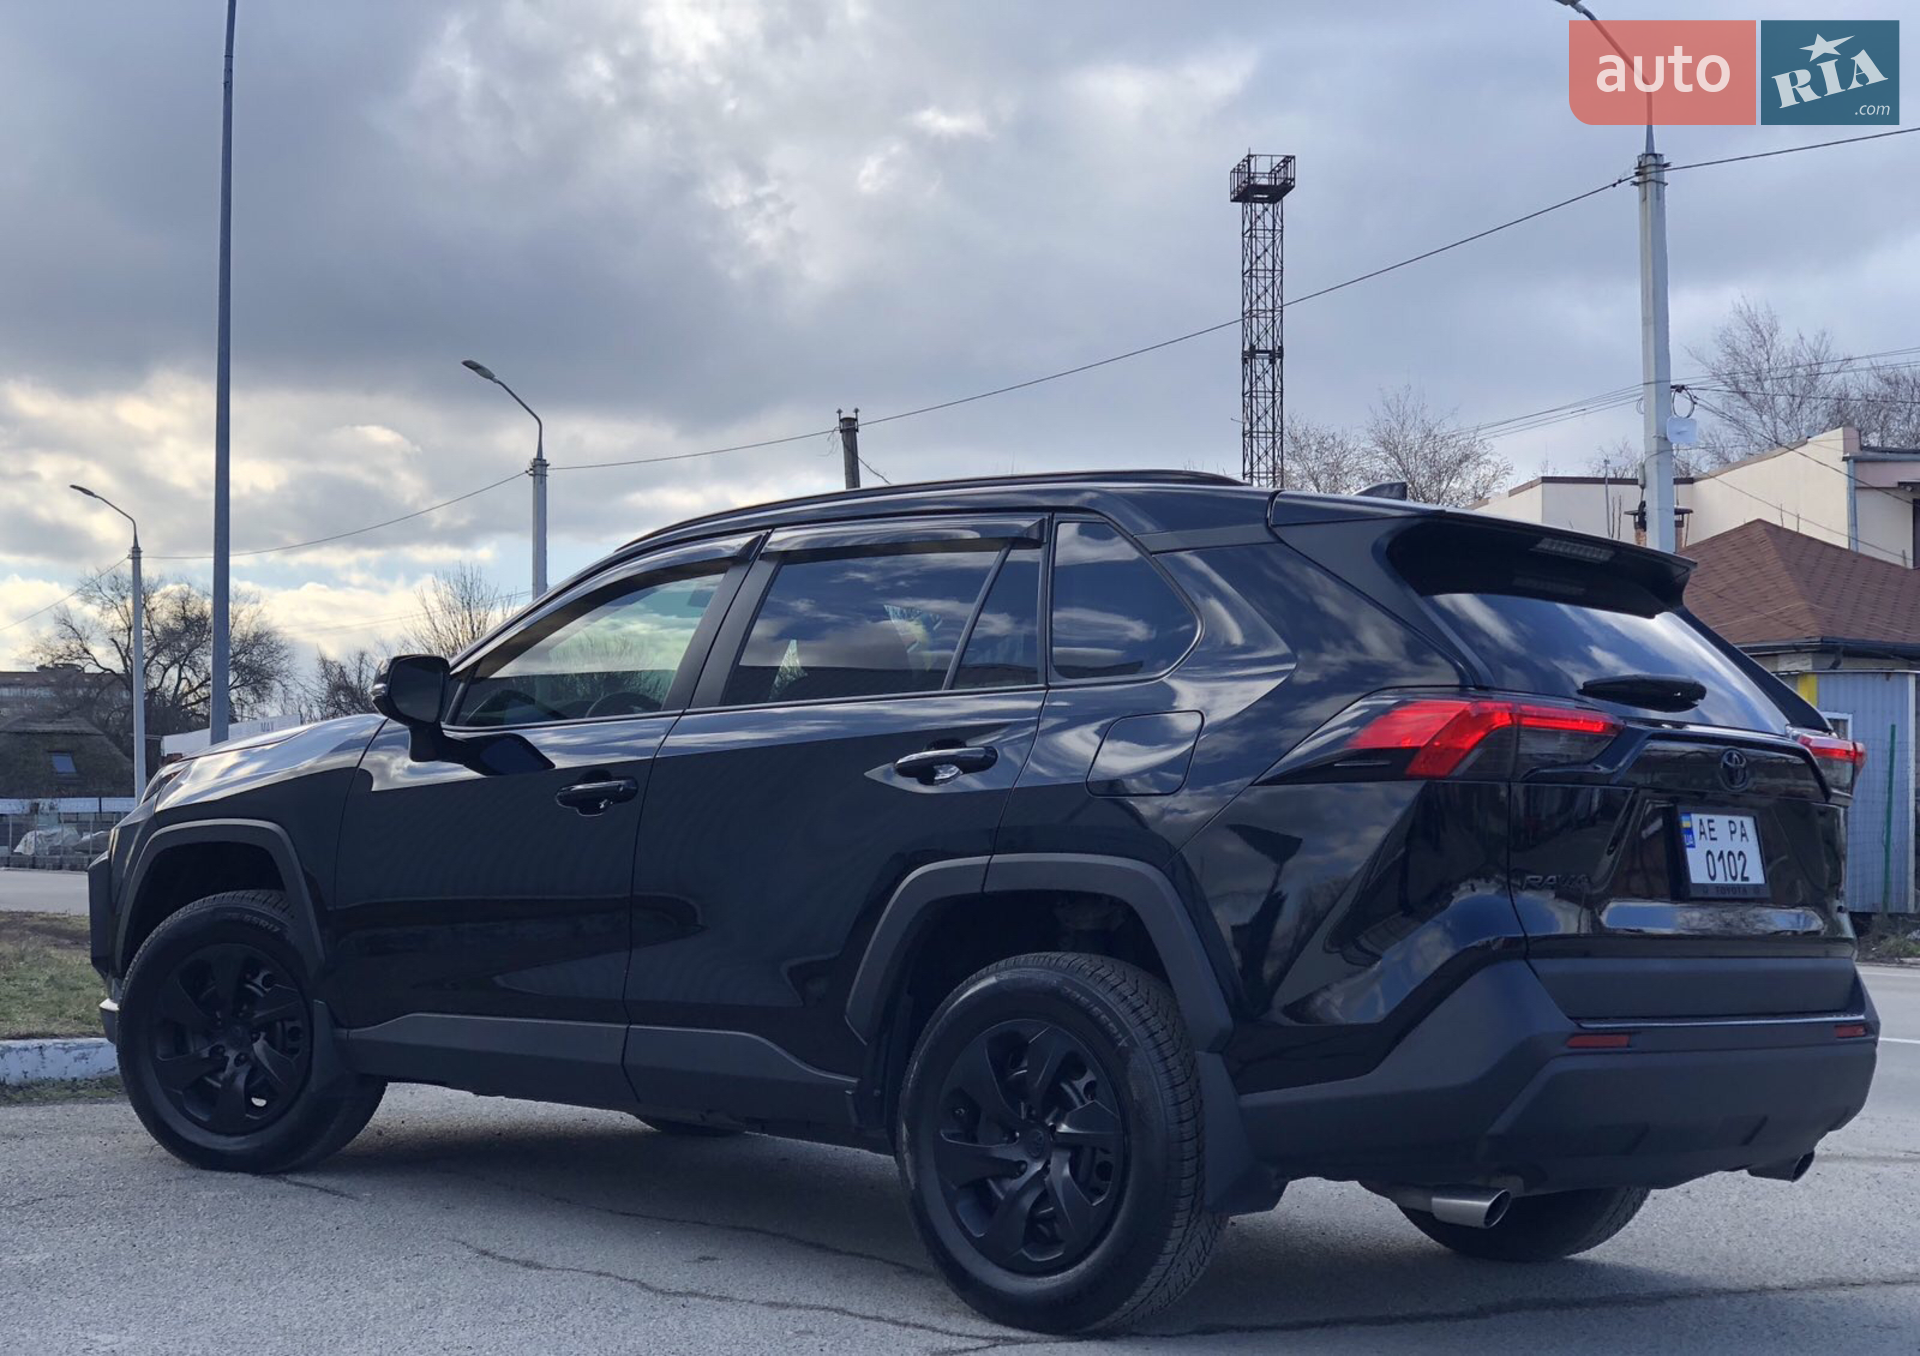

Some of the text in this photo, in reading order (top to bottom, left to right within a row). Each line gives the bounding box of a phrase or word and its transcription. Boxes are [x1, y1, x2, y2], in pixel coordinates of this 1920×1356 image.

[1699, 818, 1749, 843] AE PA
[1705, 849, 1750, 882] 0102
[1715, 885, 1748, 895] TOYOTA
